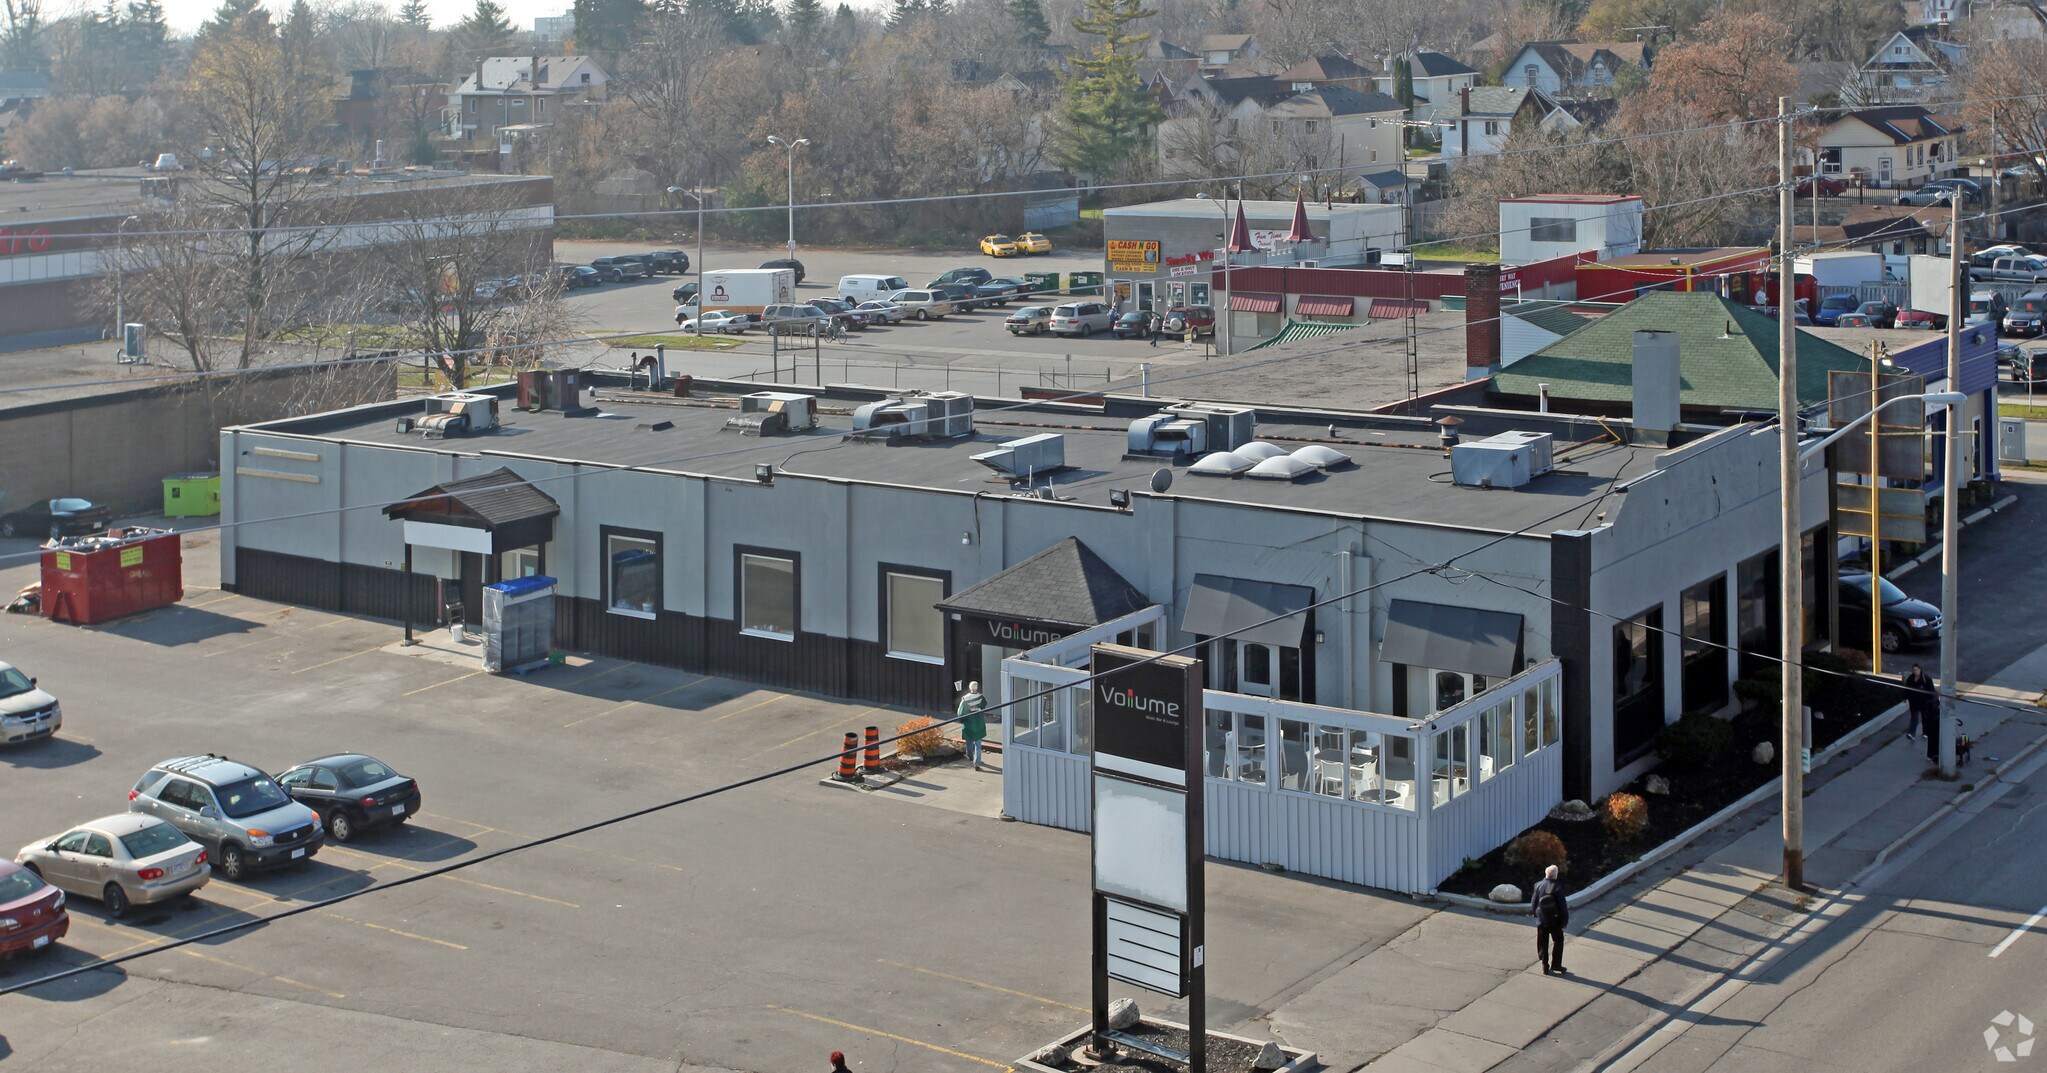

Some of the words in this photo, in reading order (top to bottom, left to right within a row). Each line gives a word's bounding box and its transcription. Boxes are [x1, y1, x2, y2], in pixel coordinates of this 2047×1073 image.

[1118, 241, 1137, 250] CASH
[1138, 242, 1144, 250] N
[1146, 242, 1156, 250] GO
